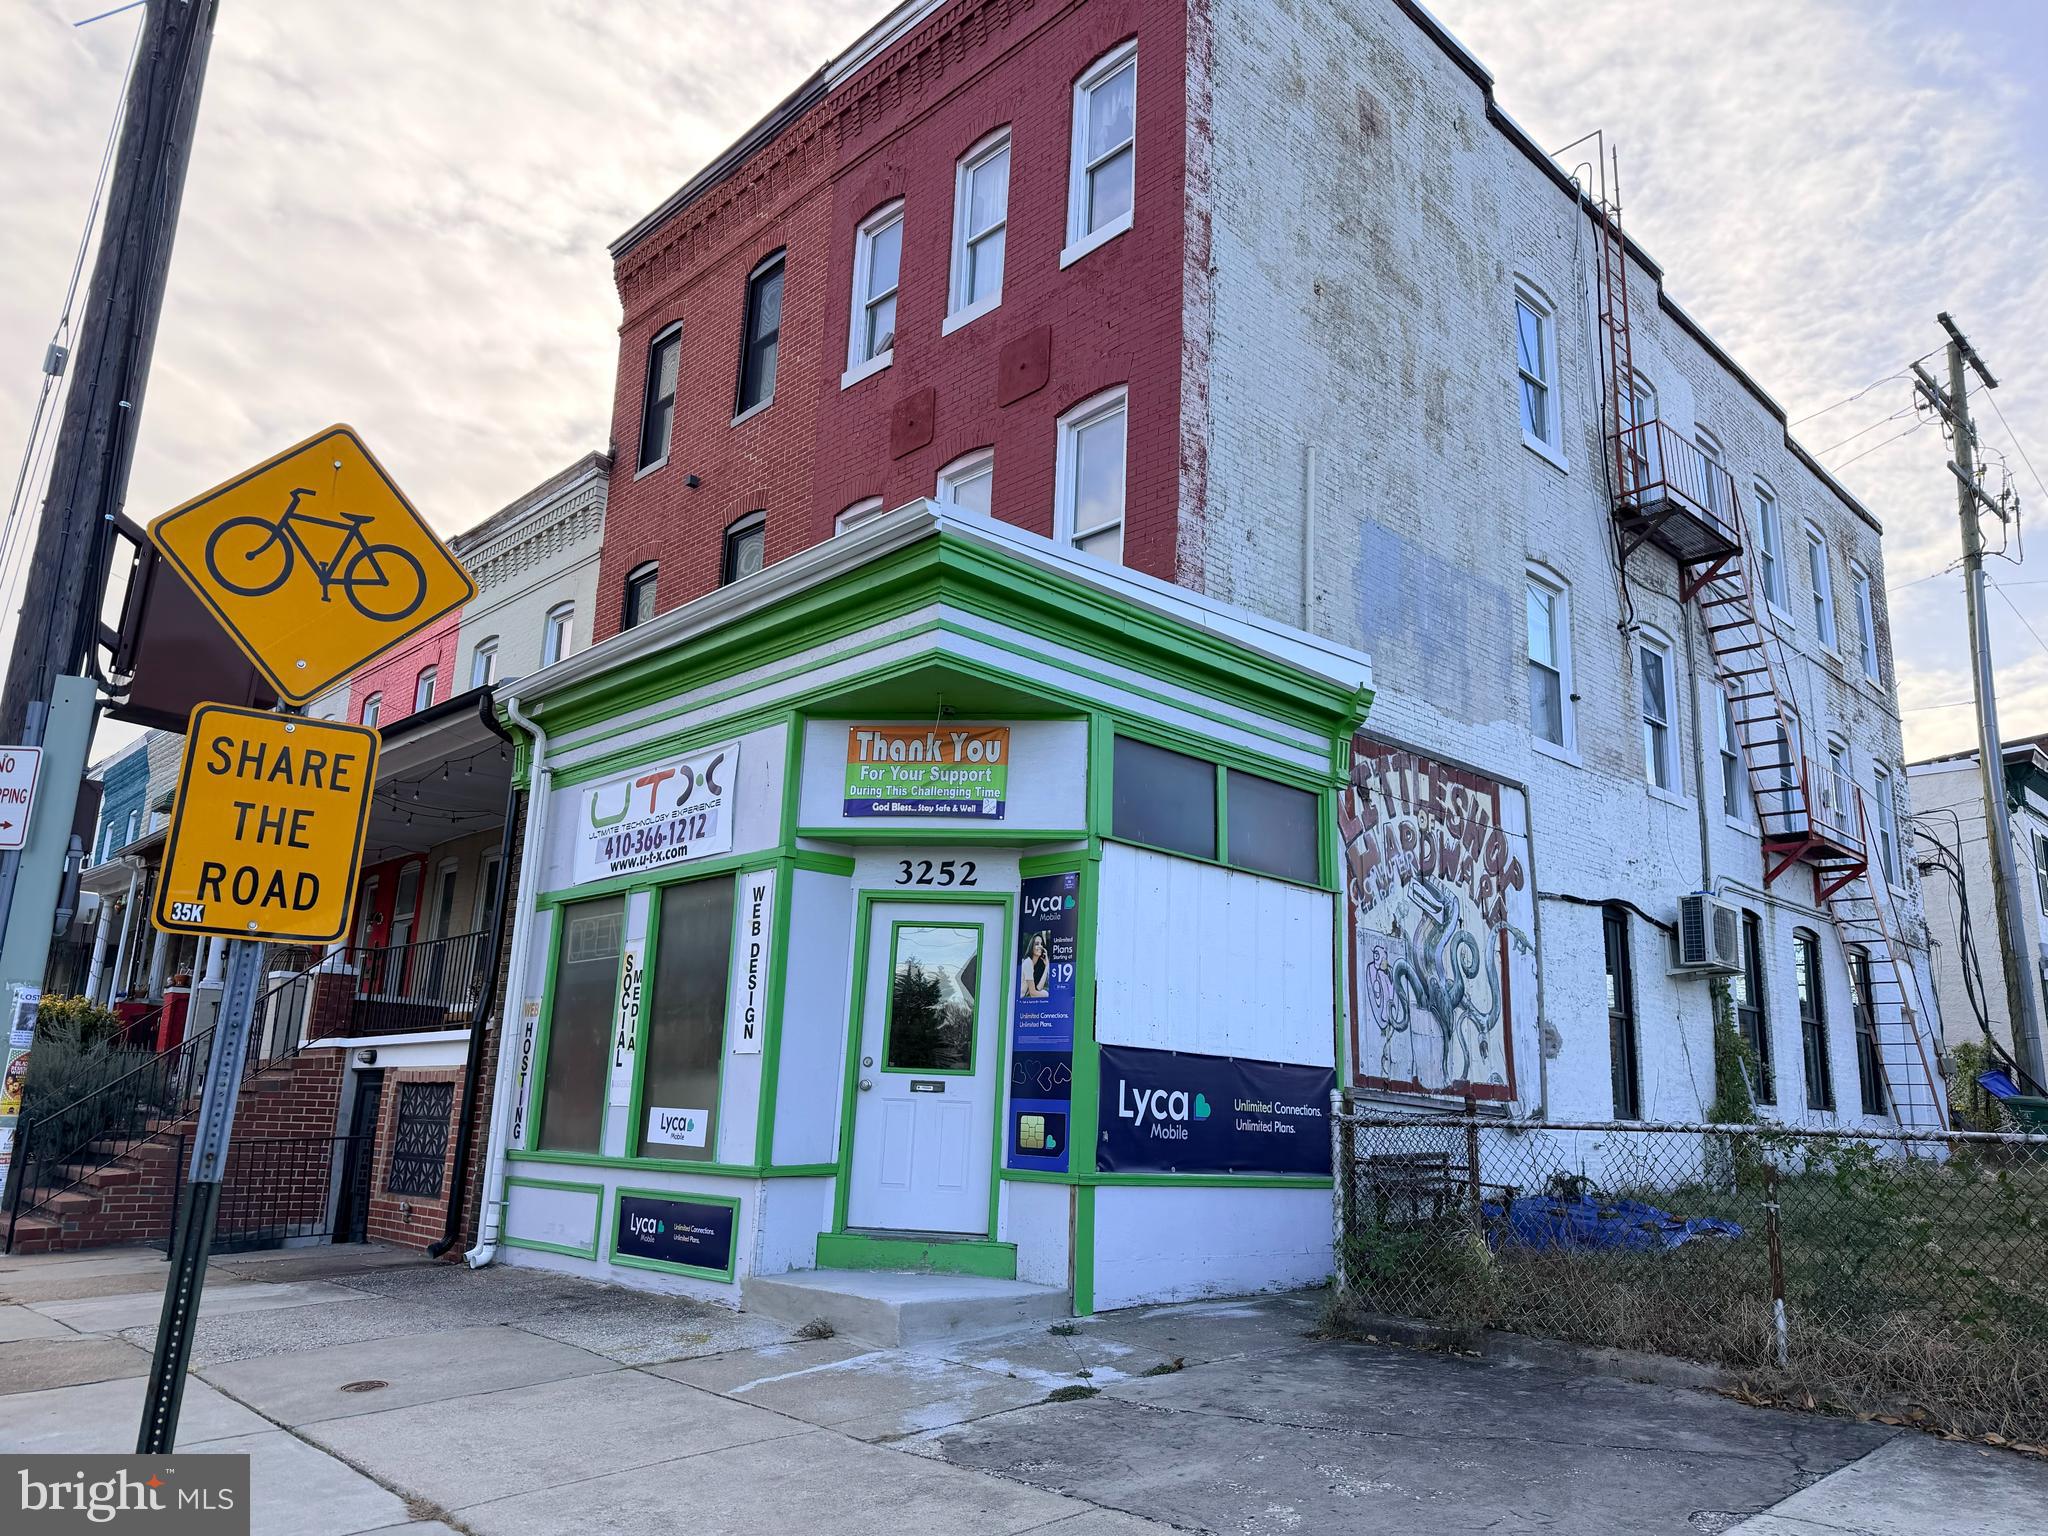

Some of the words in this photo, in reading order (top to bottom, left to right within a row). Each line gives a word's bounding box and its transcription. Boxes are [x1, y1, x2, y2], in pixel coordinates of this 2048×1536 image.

[857, 731, 943, 763] Thank
[949, 731, 1001, 763] You
[206, 735, 356, 793] SHARE
[860, 765, 886, 781] For
[890, 765, 926, 781] Your
[929, 765, 992, 785] Support
[850, 786, 883, 798] During
[886, 785, 908, 796] This
[911, 786, 972, 798] Challenging
[975, 787, 1001, 798] Time
[588, 825, 620, 840] ULTIMATE
[621, 813, 670, 832] TECHNOLOGY
[671, 798, 722, 819] EXPERIENCE
[872, 802, 890, 812] God
[891, 802, 917, 812] Bless...
[918, 804, 934, 814] Stay
[935, 804, 951, 813] Safe
[952, 804, 959, 812] &
[960, 804, 976, 813] Well
[232, 801, 315, 850] THE
[604, 813, 706, 860] 410-366-1212
[610, 845, 688, 873] www.u-t-x.com
[895, 859, 979, 888] 3252
[197, 861, 321, 912] ROAD
[171, 902, 205, 923] 35K
[751, 885, 766, 937] WEB
[1024, 895, 1062, 917] Lyca
[1040, 912, 1061, 921] Mobile
[1052, 945, 1073, 955] Plans
[1051, 963, 1073, 983] $19
[743, 942, 761, 1040] DESIGN
[615, 953, 634, 1068] SOCIAL
[627, 969, 643, 1051] MEDIA
[513, 1022, 534, 1140] HOSTING
[1118, 1079, 1189, 1127] Lyca
[1234, 1098, 1272, 1113] Unlimited
[1274, 1101, 1322, 1118] Connections.
[660, 1112, 686, 1134] Lyca
[1150, 1123, 1188, 1140] Mobile
[1235, 1118, 1272, 1133] Unlimited
[1274, 1121, 1296, 1134] Plans.
[670, 1132, 685, 1141] Mobile
[630, 1212, 657, 1235] Lyca
[640, 1234, 655, 1243] Mobile
